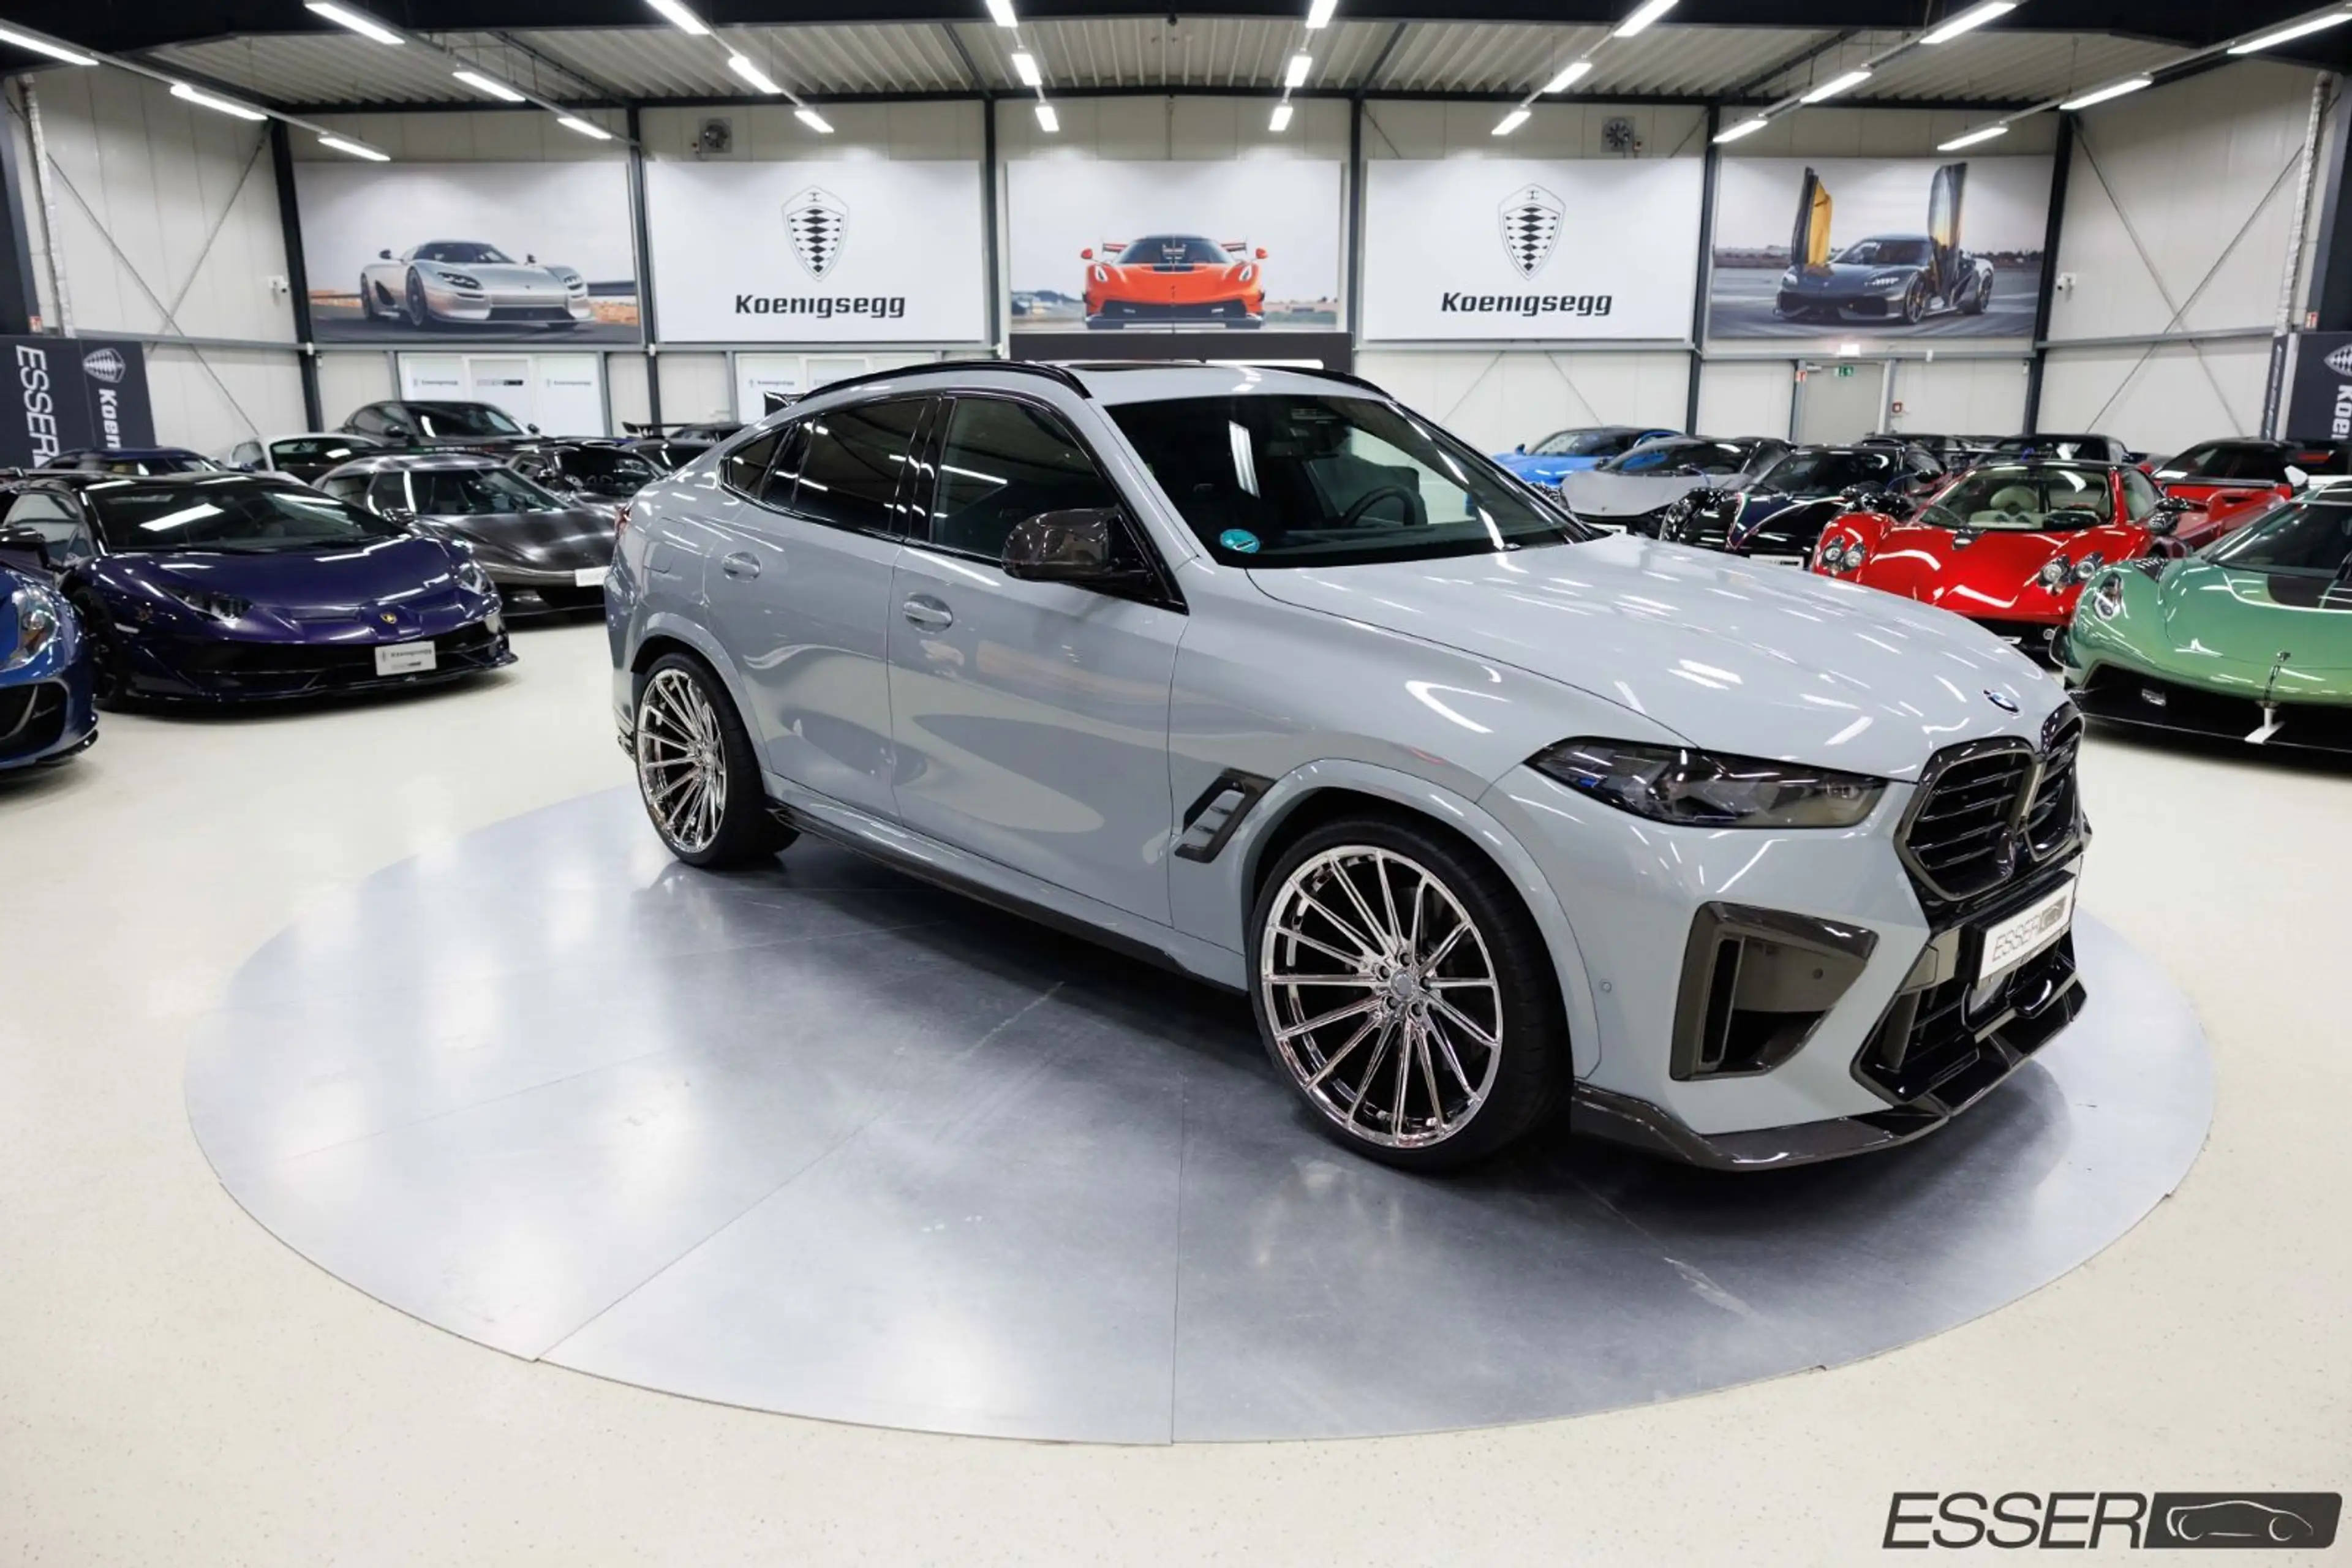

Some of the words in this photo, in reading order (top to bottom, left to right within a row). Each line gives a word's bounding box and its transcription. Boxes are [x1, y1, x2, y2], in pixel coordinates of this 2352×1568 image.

[735, 295, 905, 318] Koenigsegg
[1441, 292, 1612, 317] Koenigsegg
[16, 345, 59, 457] ESSER
